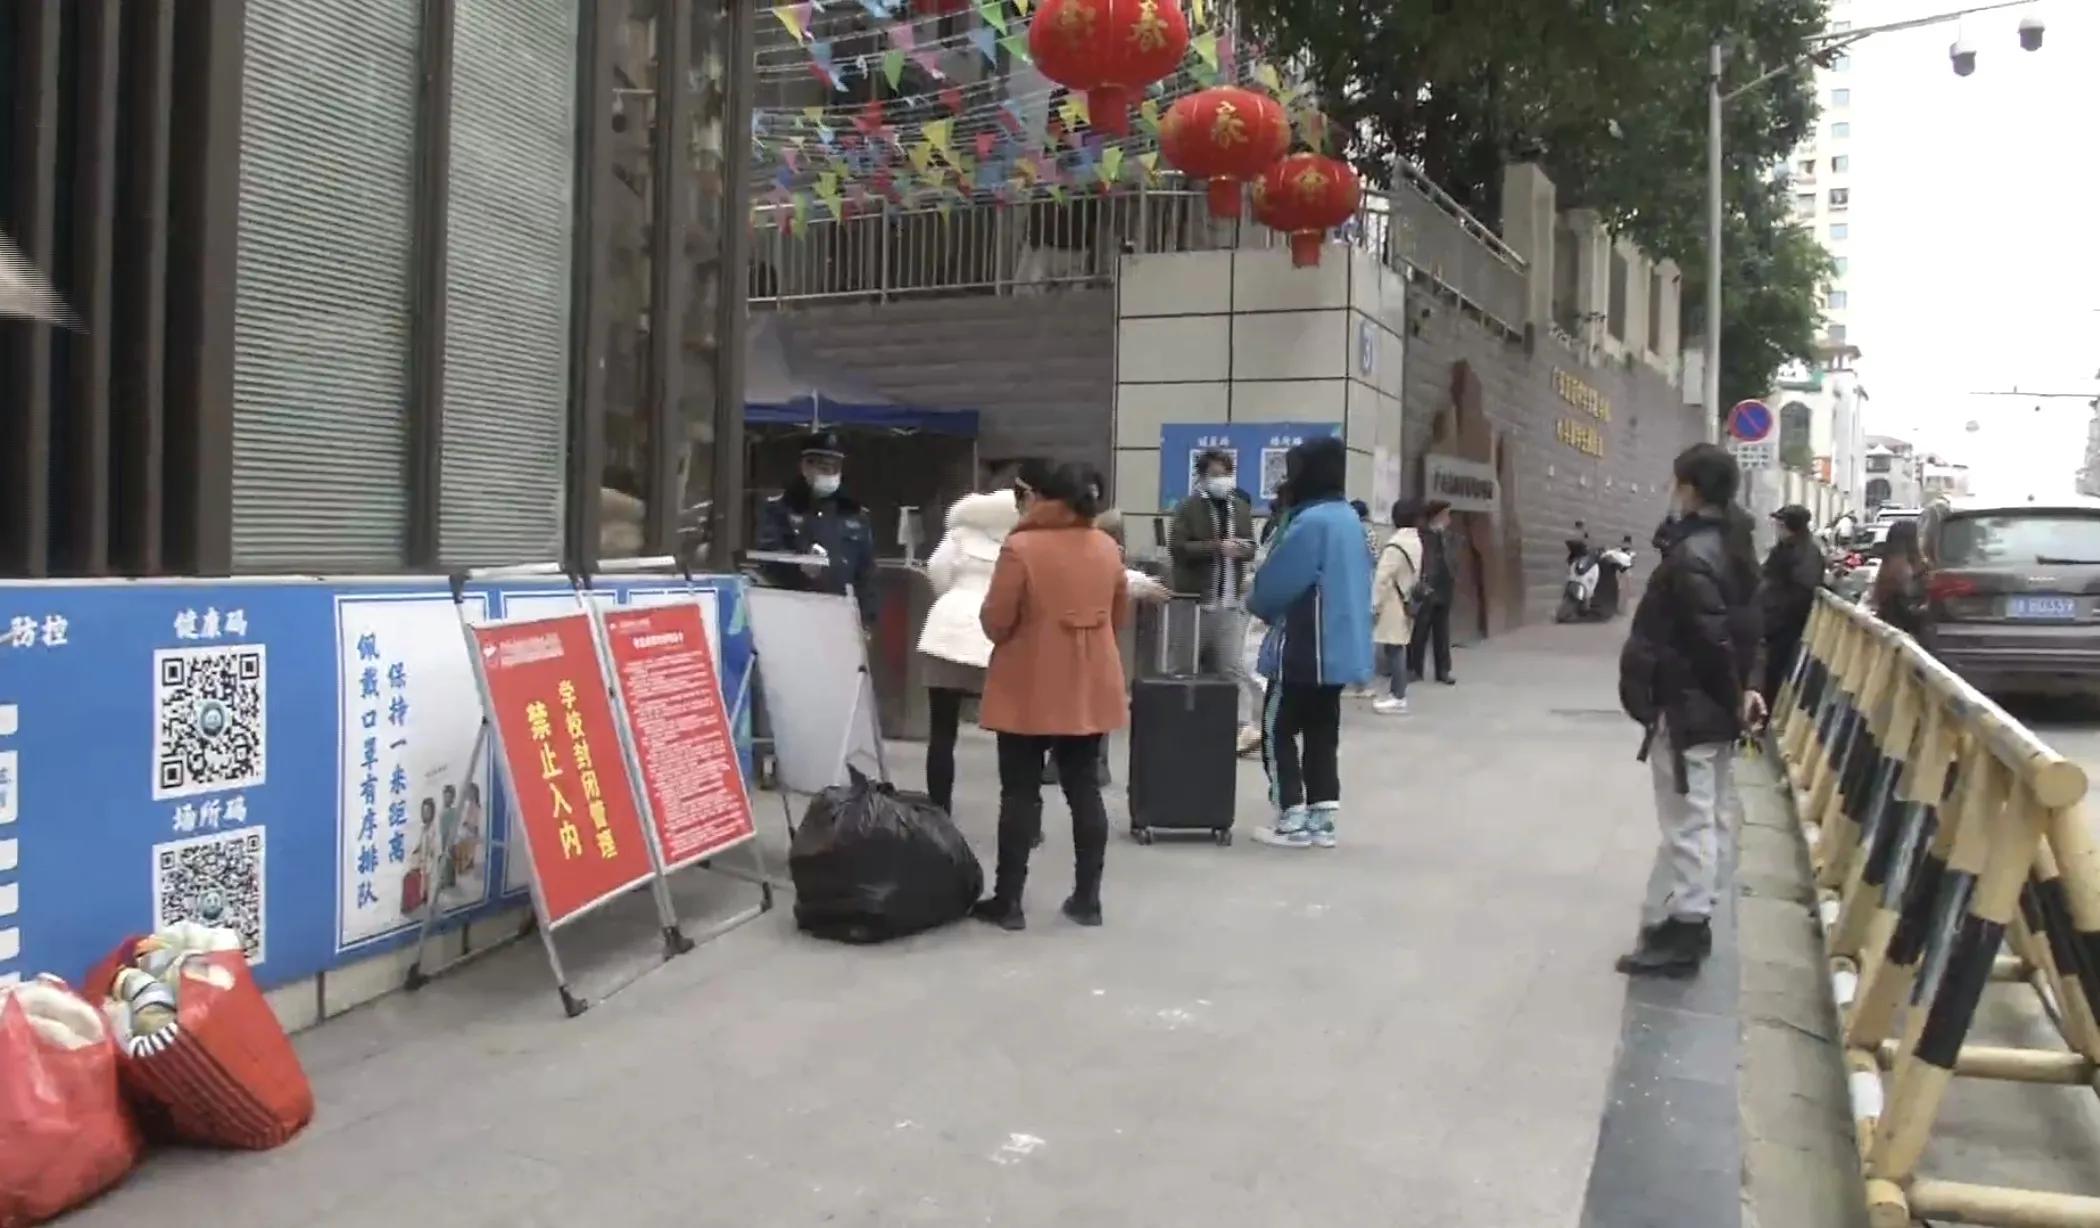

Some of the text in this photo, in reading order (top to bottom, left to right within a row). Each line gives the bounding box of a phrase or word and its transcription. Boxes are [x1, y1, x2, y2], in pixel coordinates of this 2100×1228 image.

[173, 606, 248, 640] 健康码
[172, 800, 248, 832] 场所码
[356, 632, 381, 910] 佩戴口罩有序排队
[386, 662, 411, 864] 保持一米距离
[525, 700, 582, 861] 禁止入内
[558, 679, 618, 860] 学校封闭管理
